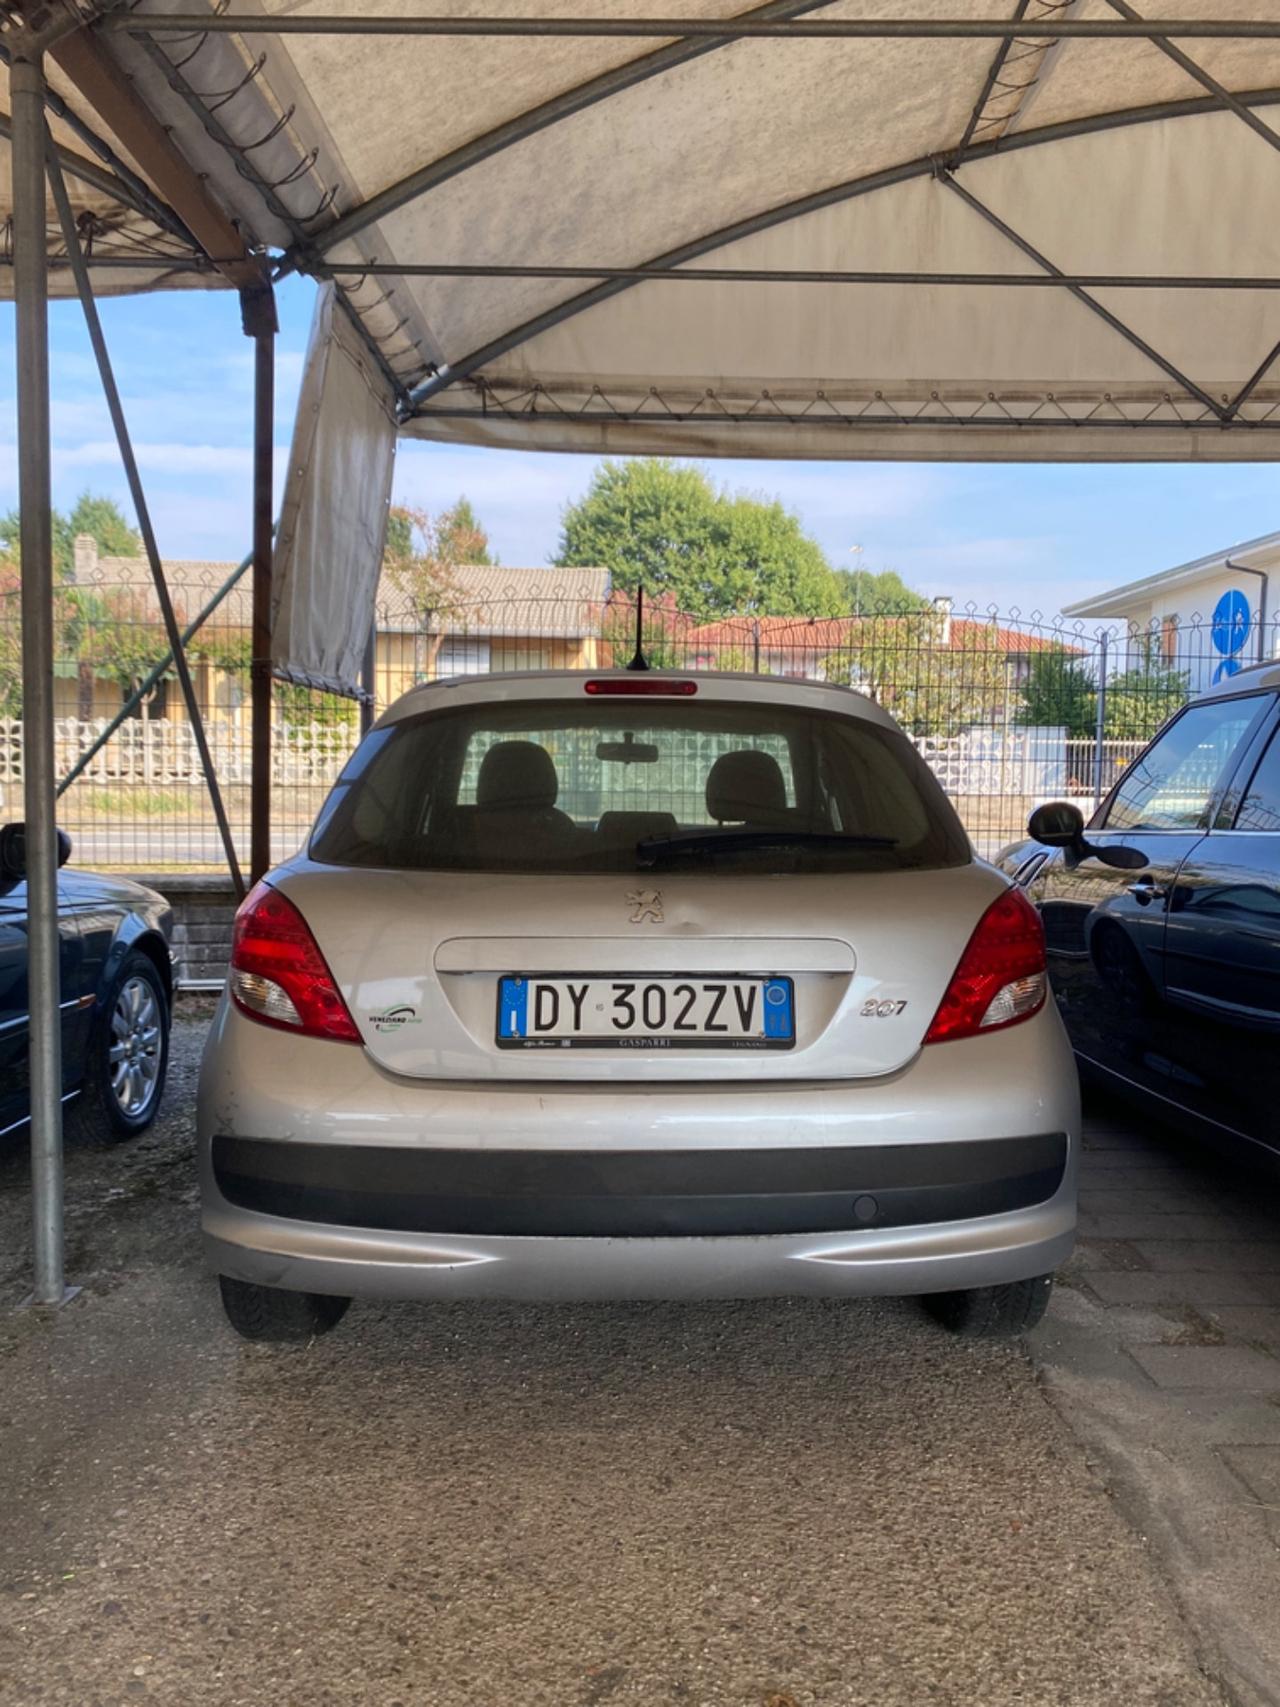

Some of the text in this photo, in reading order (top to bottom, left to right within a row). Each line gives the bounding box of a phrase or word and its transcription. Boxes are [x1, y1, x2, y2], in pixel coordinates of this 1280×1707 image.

[534, 983, 757, 1032] DY 302ZV
[860, 998, 908, 1017] 207
[618, 1039, 672, 1048] GASPARRI
